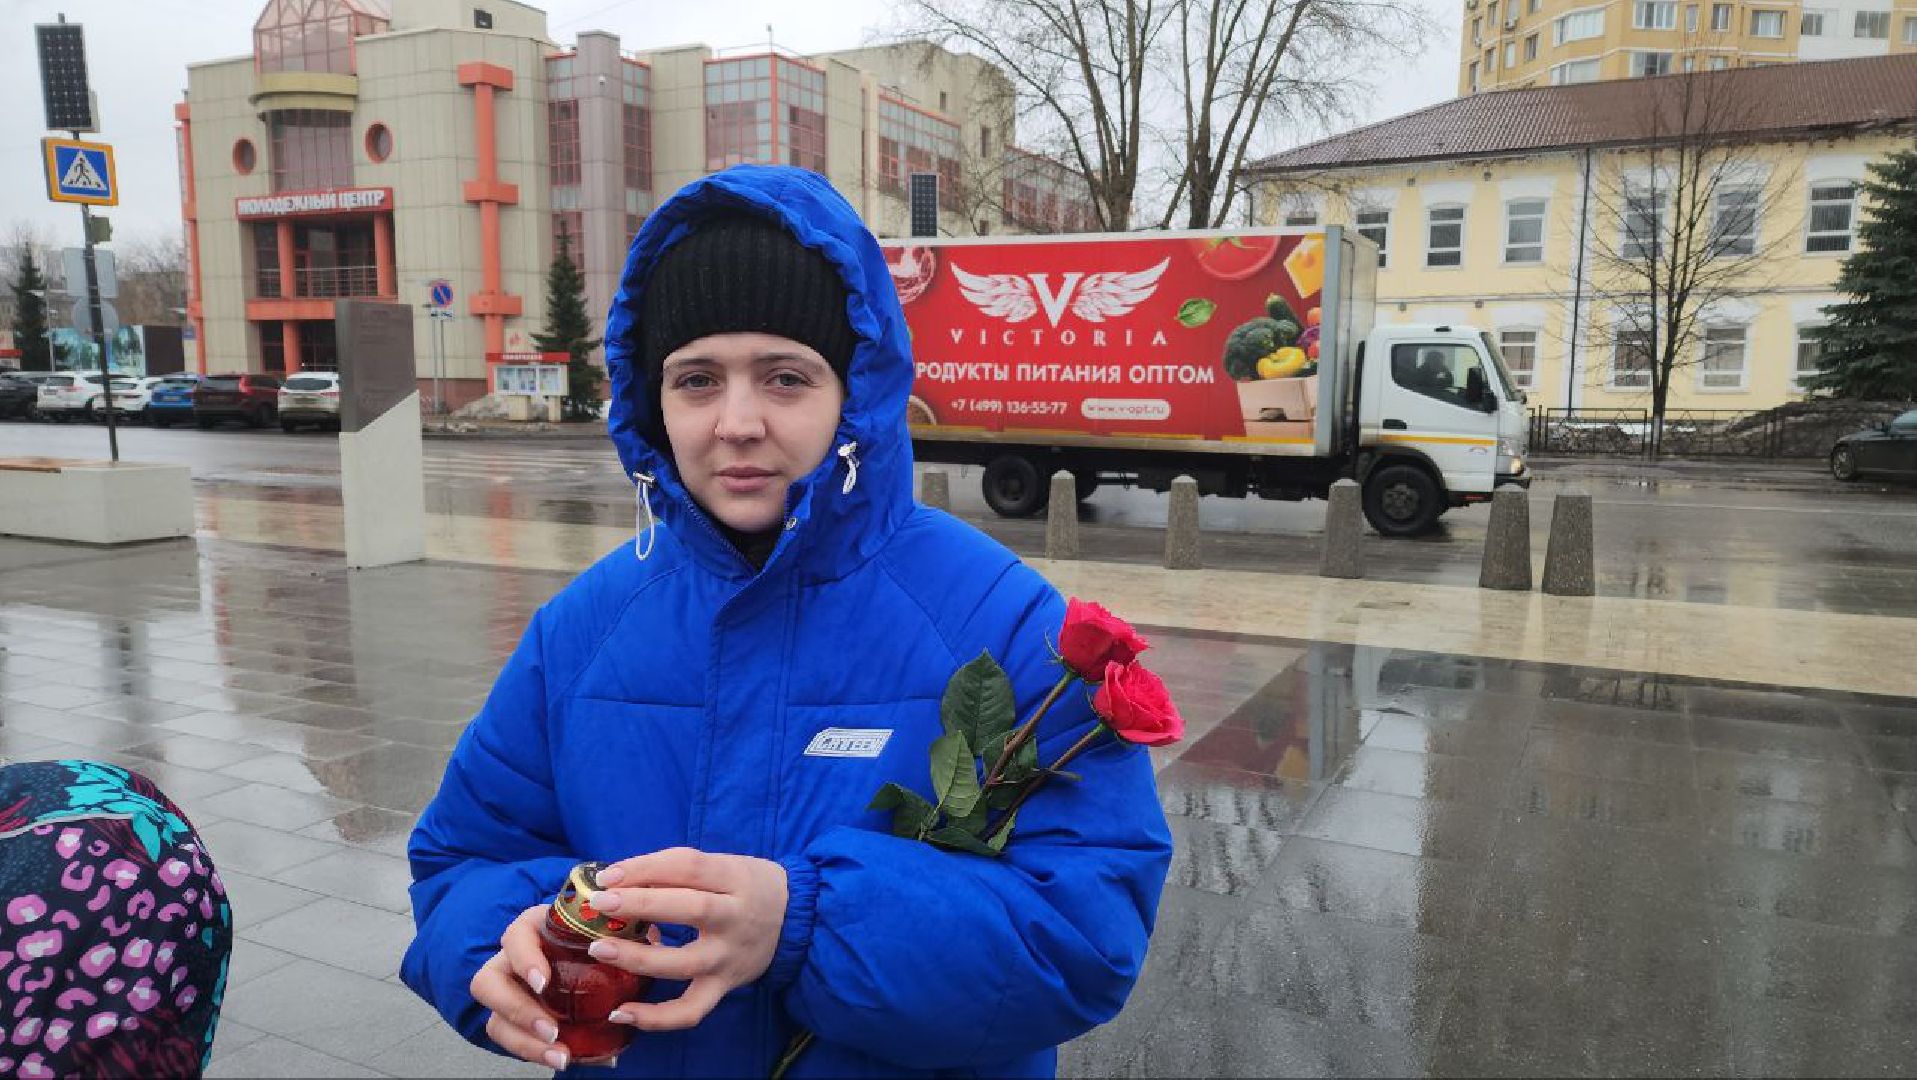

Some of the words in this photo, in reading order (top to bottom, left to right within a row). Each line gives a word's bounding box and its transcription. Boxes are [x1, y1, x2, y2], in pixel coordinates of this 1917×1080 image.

[339, 189, 385, 211] ЦЕНТР
[1027, 272, 1085, 328] V
[951, 328, 1168, 346] VICTORIA
[1016, 363, 1121, 384] ПИТАНИЯ
[1128, 364, 1215, 384] ОПТОМ
[951, 399, 966, 411] +7
[970, 399, 1003, 414] (499)
[1006, 401, 1068, 415] 136-55-77
